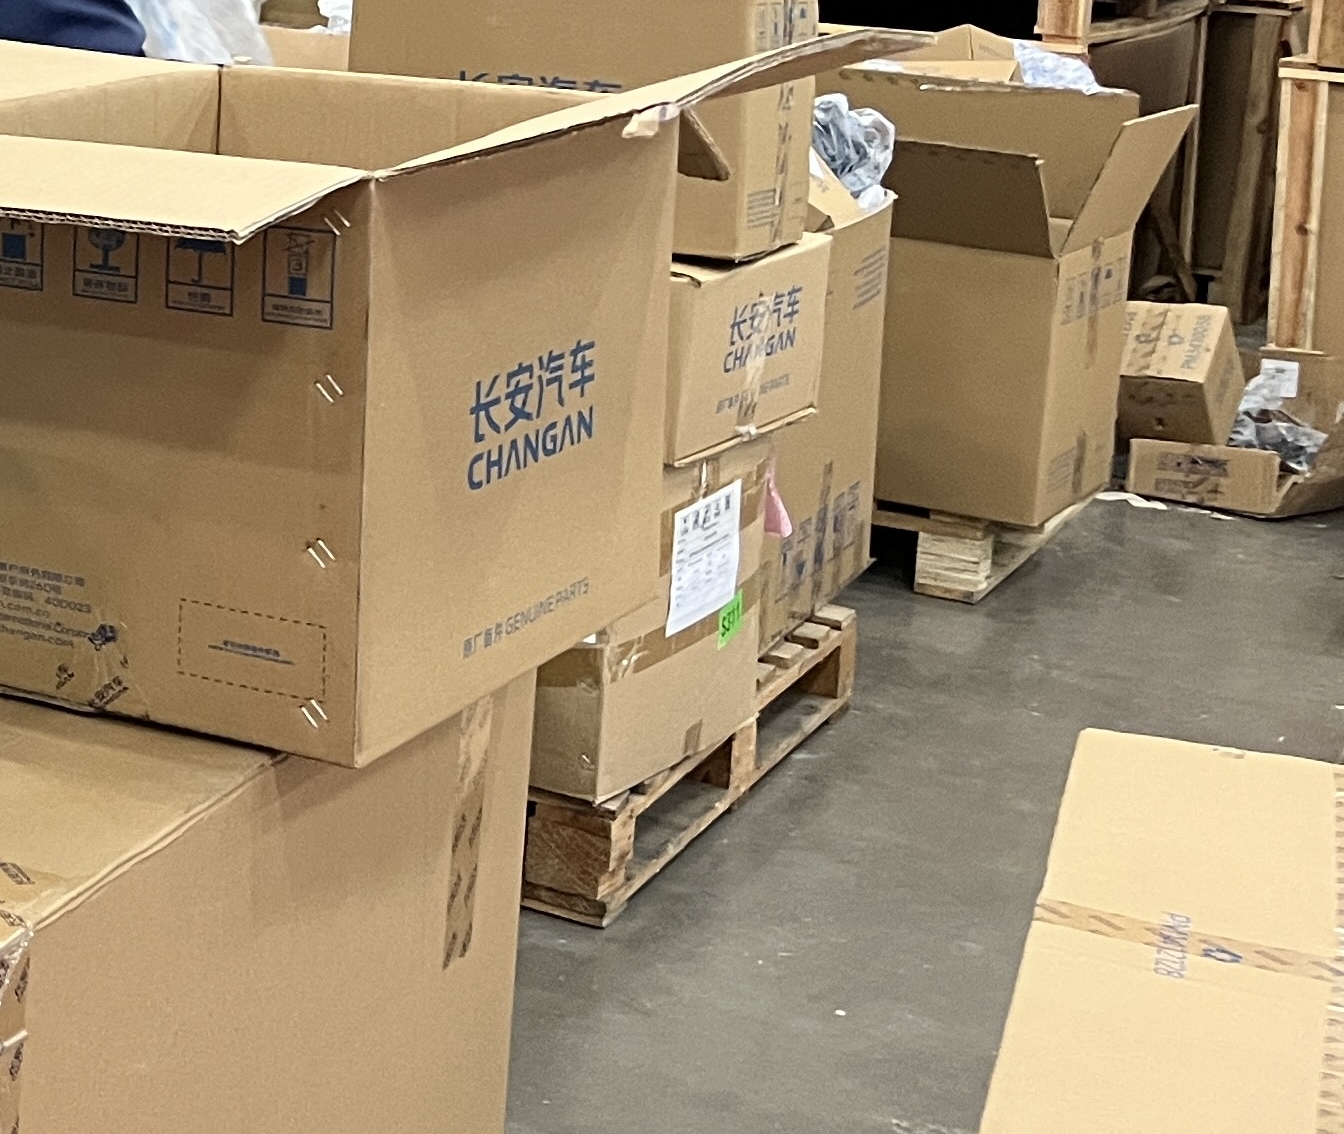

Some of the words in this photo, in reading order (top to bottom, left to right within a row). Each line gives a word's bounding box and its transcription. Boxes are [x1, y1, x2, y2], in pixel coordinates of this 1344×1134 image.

[469, 338, 596, 444] 长安汽车
[466, 405, 594, 492] CHANGAN
